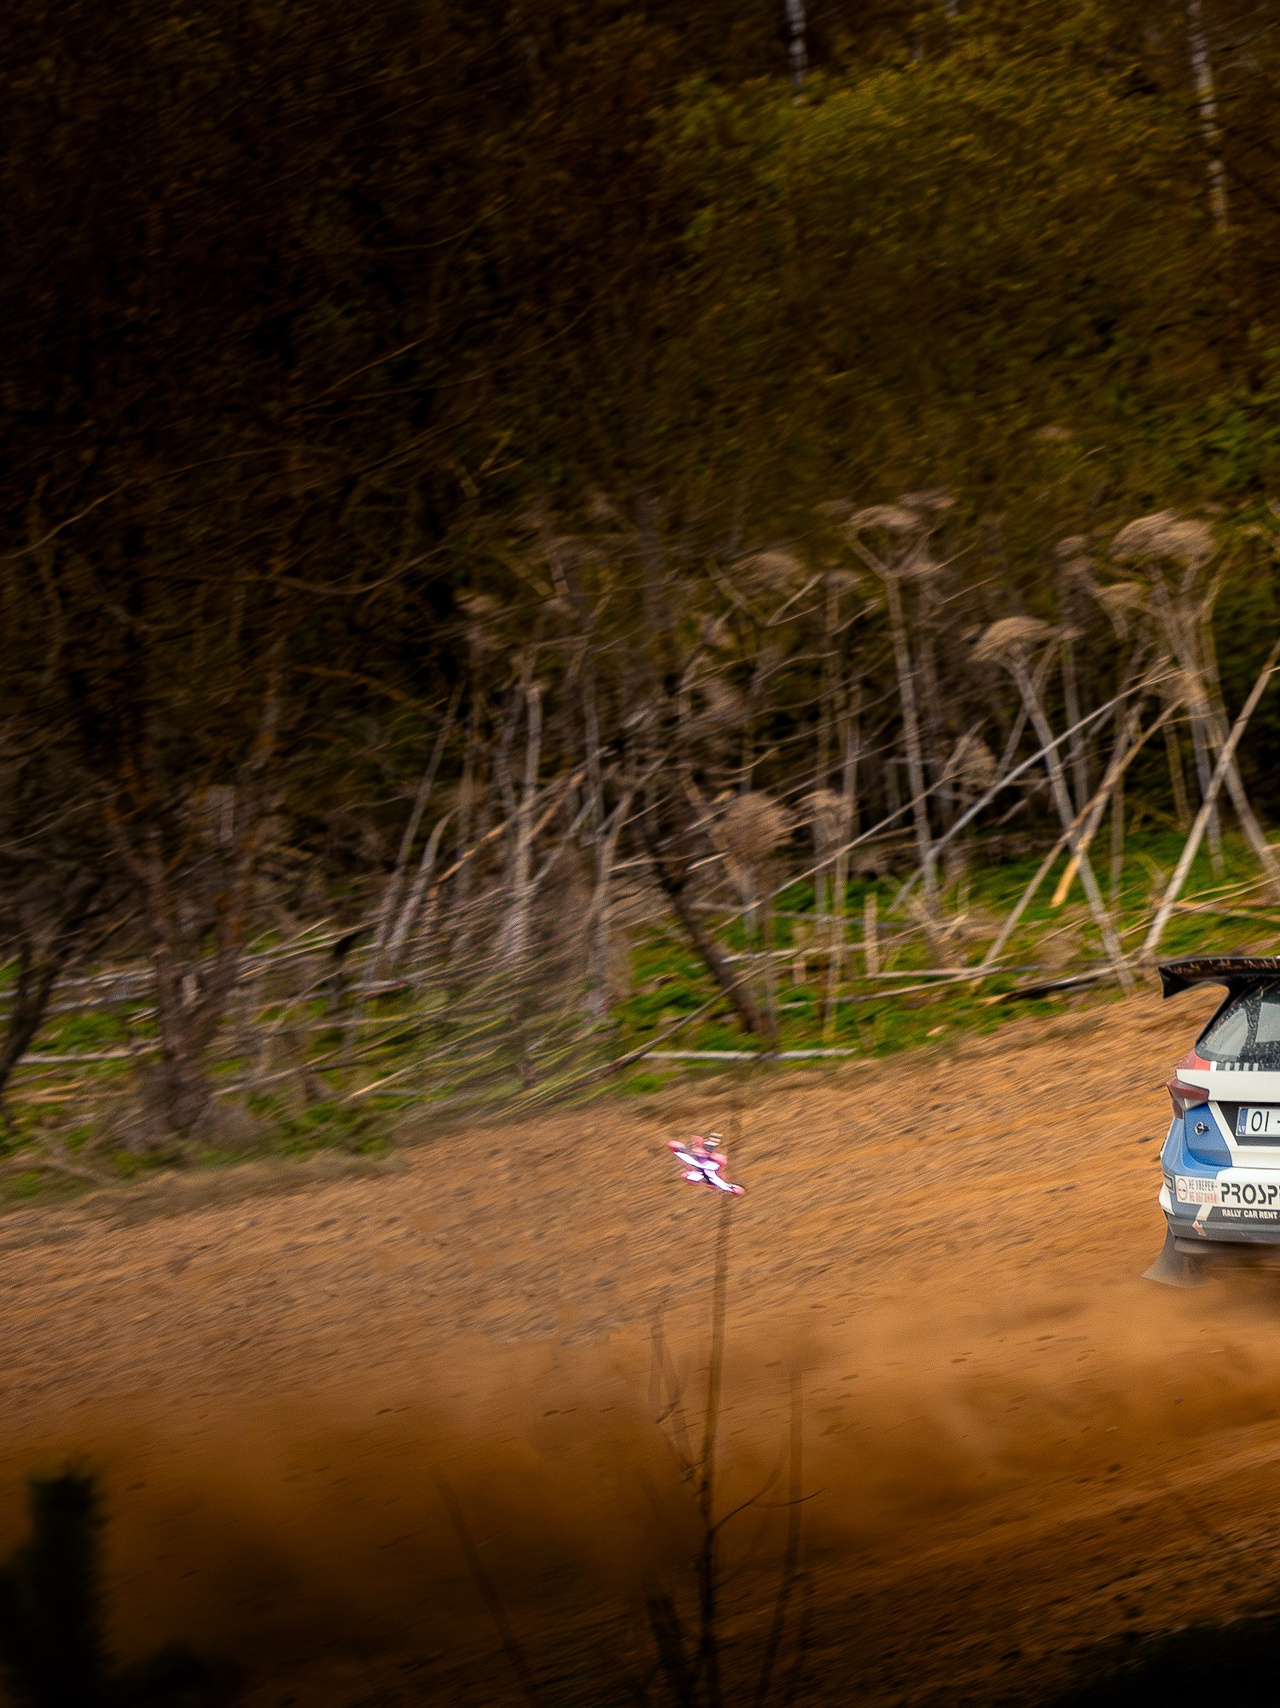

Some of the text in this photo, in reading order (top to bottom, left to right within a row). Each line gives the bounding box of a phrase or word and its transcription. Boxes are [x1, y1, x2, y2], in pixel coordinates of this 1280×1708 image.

[1222, 1208, 1242, 1218] RALLY
[1244, 1209, 1257, 1218] CAR
[1259, 1210, 1277, 1220] RENT
